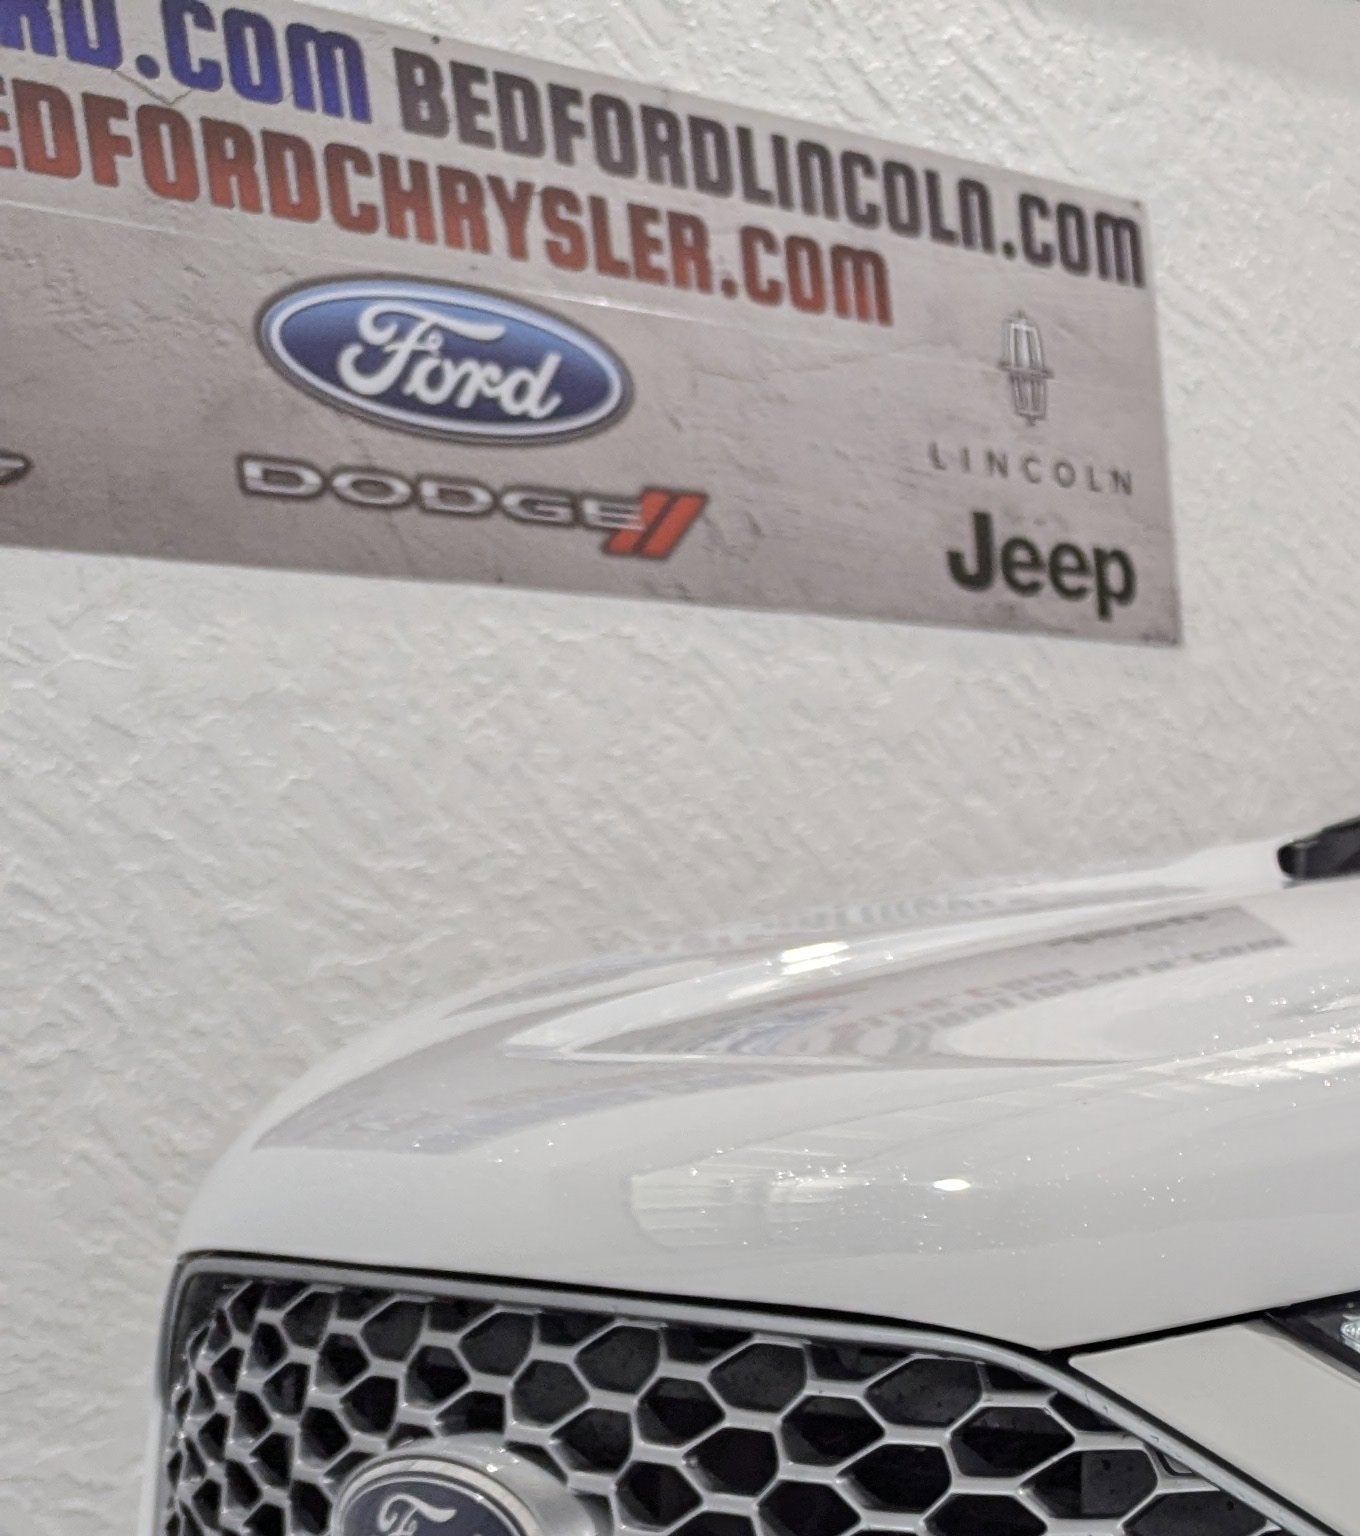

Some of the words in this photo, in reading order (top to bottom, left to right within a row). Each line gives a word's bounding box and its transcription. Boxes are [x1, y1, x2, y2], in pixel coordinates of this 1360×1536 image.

[392, 47, 1146, 289] BEDFORDLINCOLN.COM
[337, 301, 563, 419] Ford
[236, 454, 645, 532] DODGE
[928, 441, 1134, 496] LINCOLN
[946, 509, 1137, 622] Jeep
